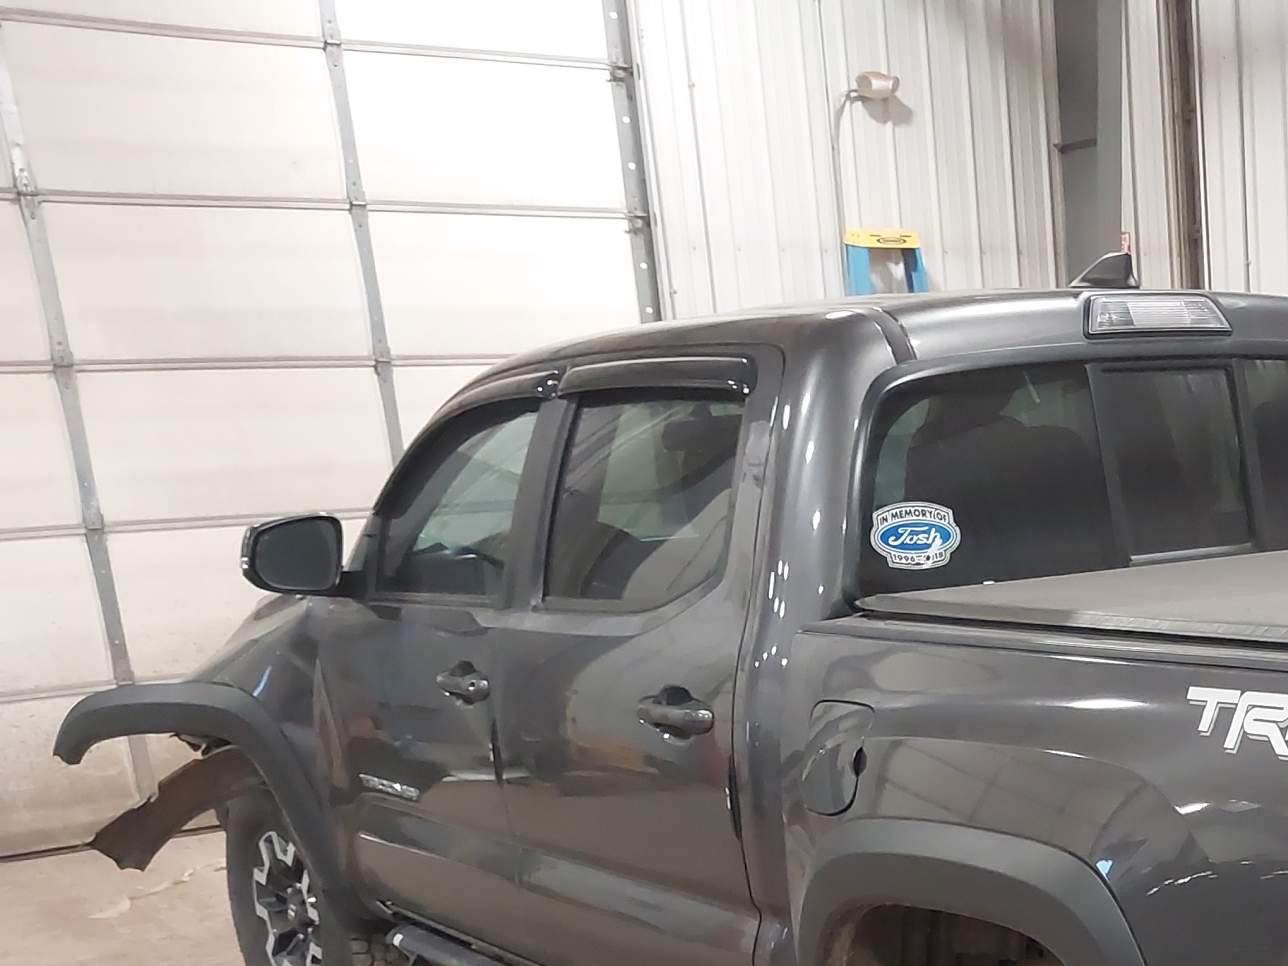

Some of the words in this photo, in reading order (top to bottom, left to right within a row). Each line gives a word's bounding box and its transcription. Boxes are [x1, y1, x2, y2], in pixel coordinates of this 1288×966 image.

[879, 514, 889, 525] IN
[891, 508, 933, 521] MEMORY
[936, 511, 947, 523] OF
[888, 527, 943, 546] Josh
